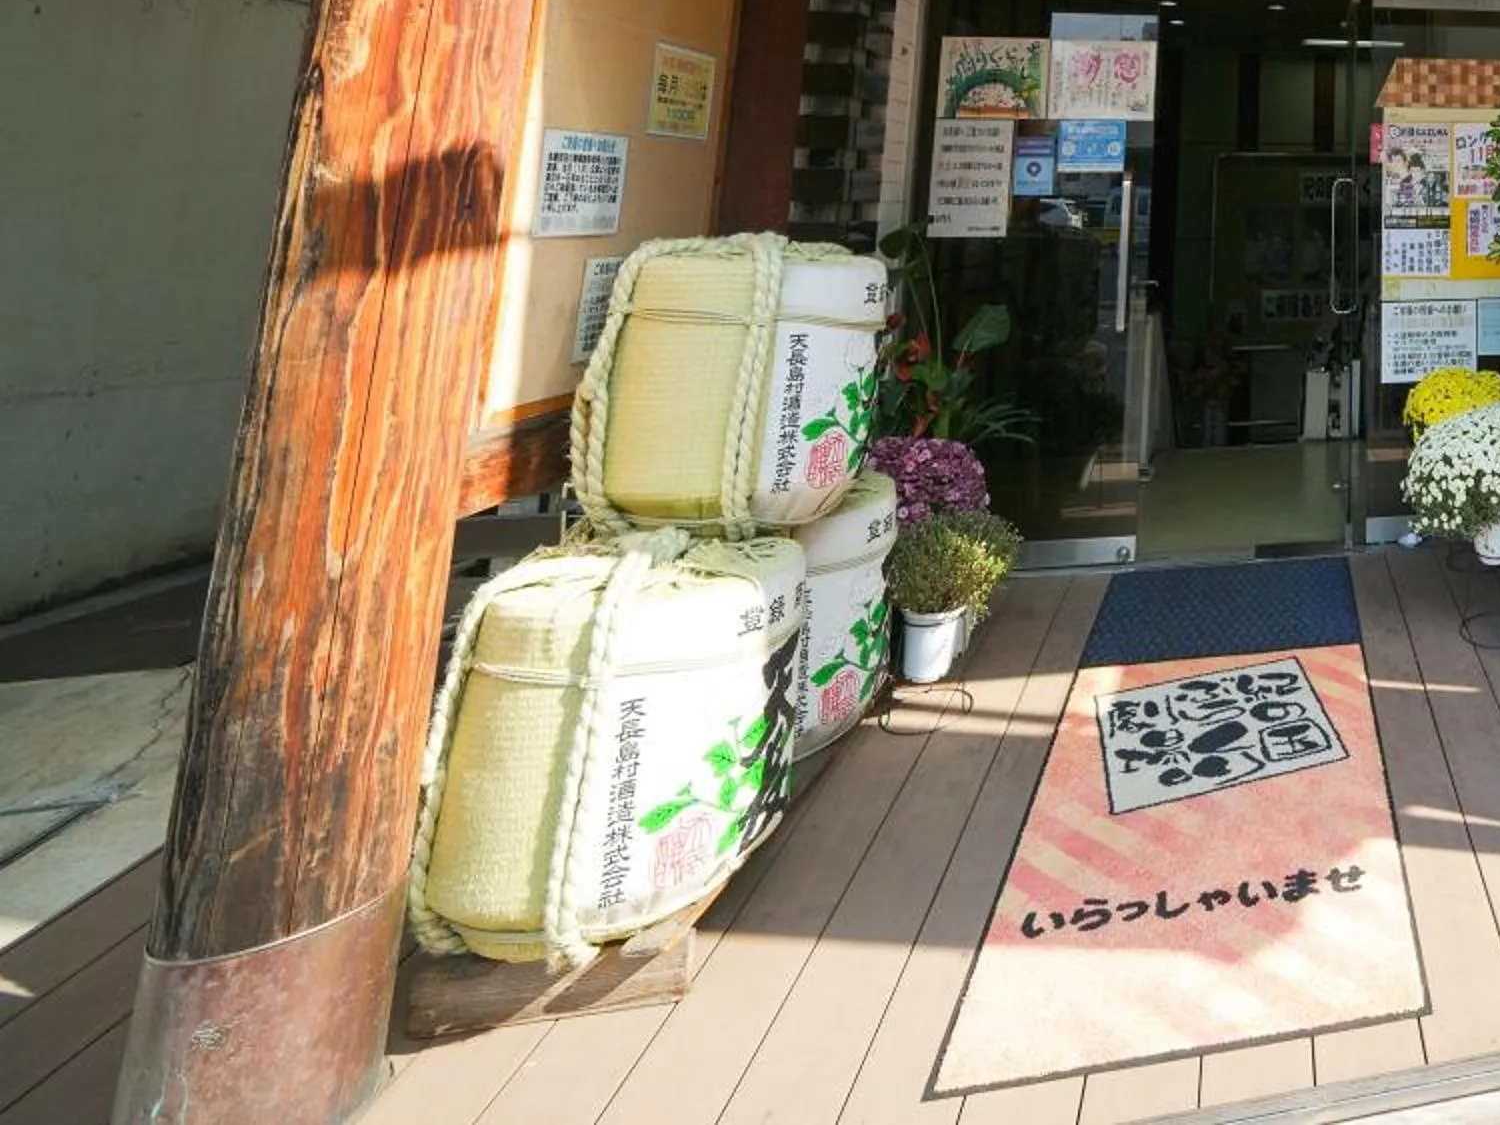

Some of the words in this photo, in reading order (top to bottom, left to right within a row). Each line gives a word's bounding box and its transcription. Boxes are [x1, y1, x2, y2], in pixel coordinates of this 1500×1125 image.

[770, 333, 809, 494] 天長島村酒造株式会社
[597, 697, 647, 910] 天長島村酒造株式会社
[1021, 865, 1366, 940] いらっしゃいませ
